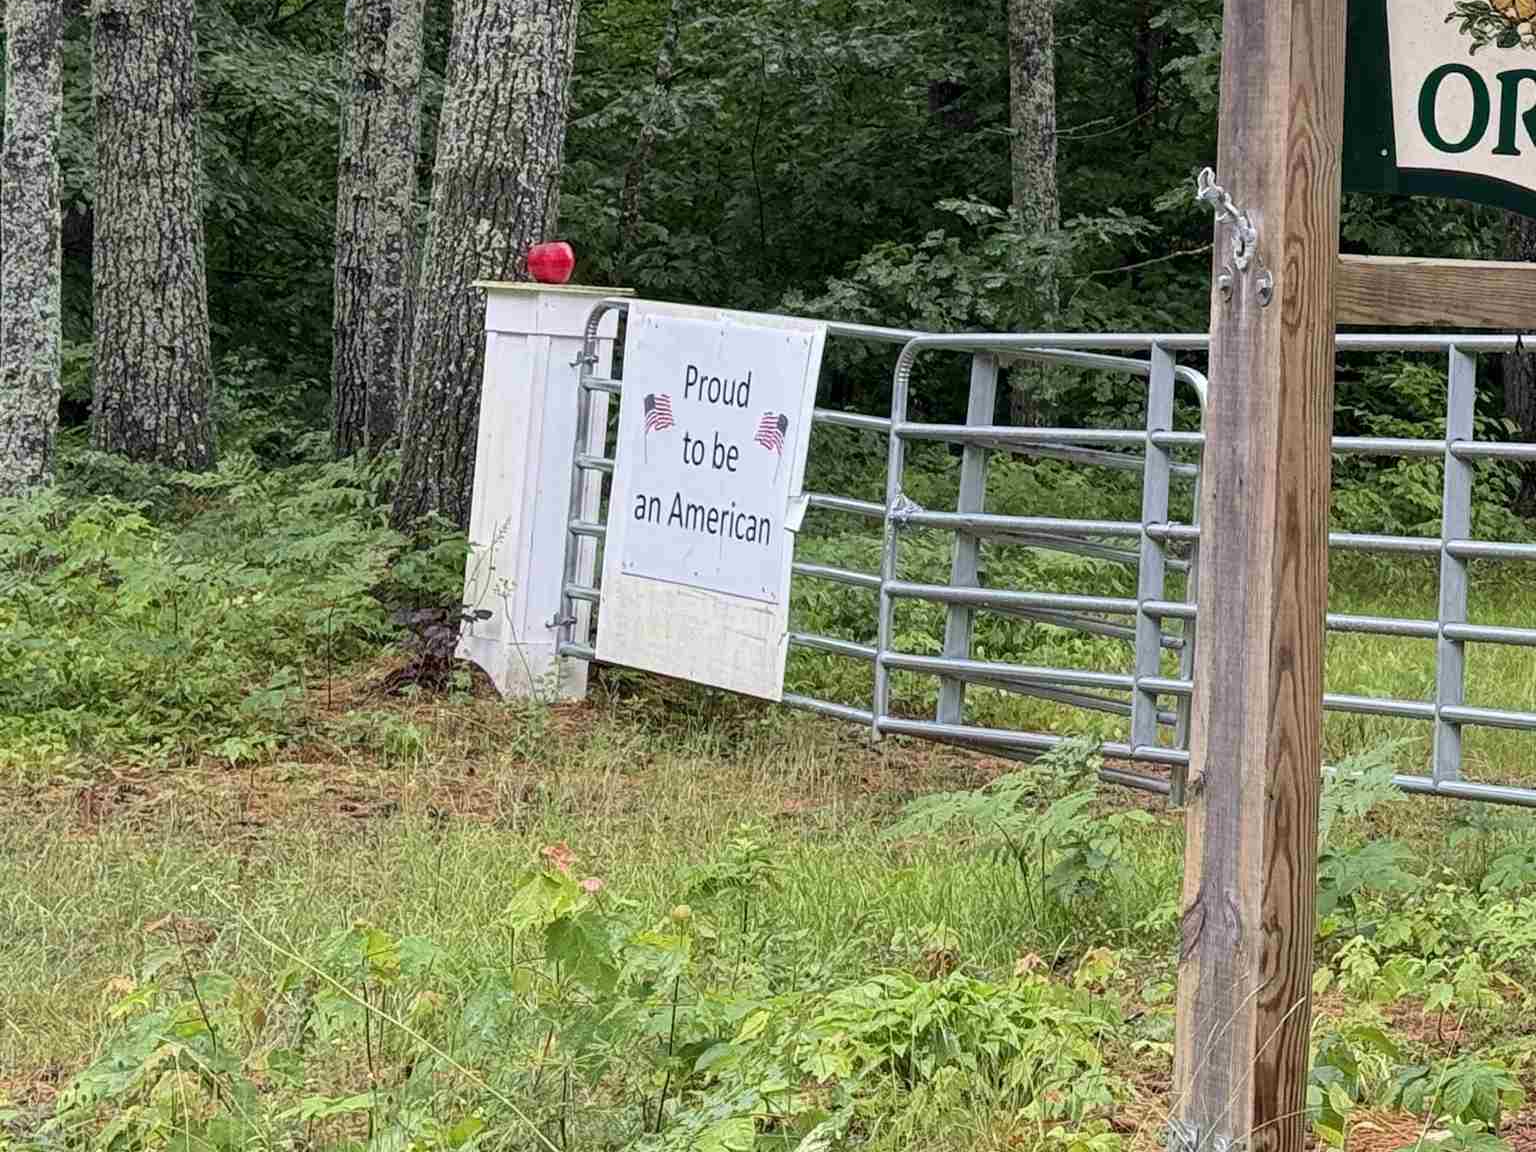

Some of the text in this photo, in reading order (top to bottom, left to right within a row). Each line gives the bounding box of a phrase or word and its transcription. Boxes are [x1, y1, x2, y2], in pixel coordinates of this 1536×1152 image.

[683, 364, 752, 409] Proud
[682, 431, 739, 473] to be
[633, 492, 771, 546] an American
